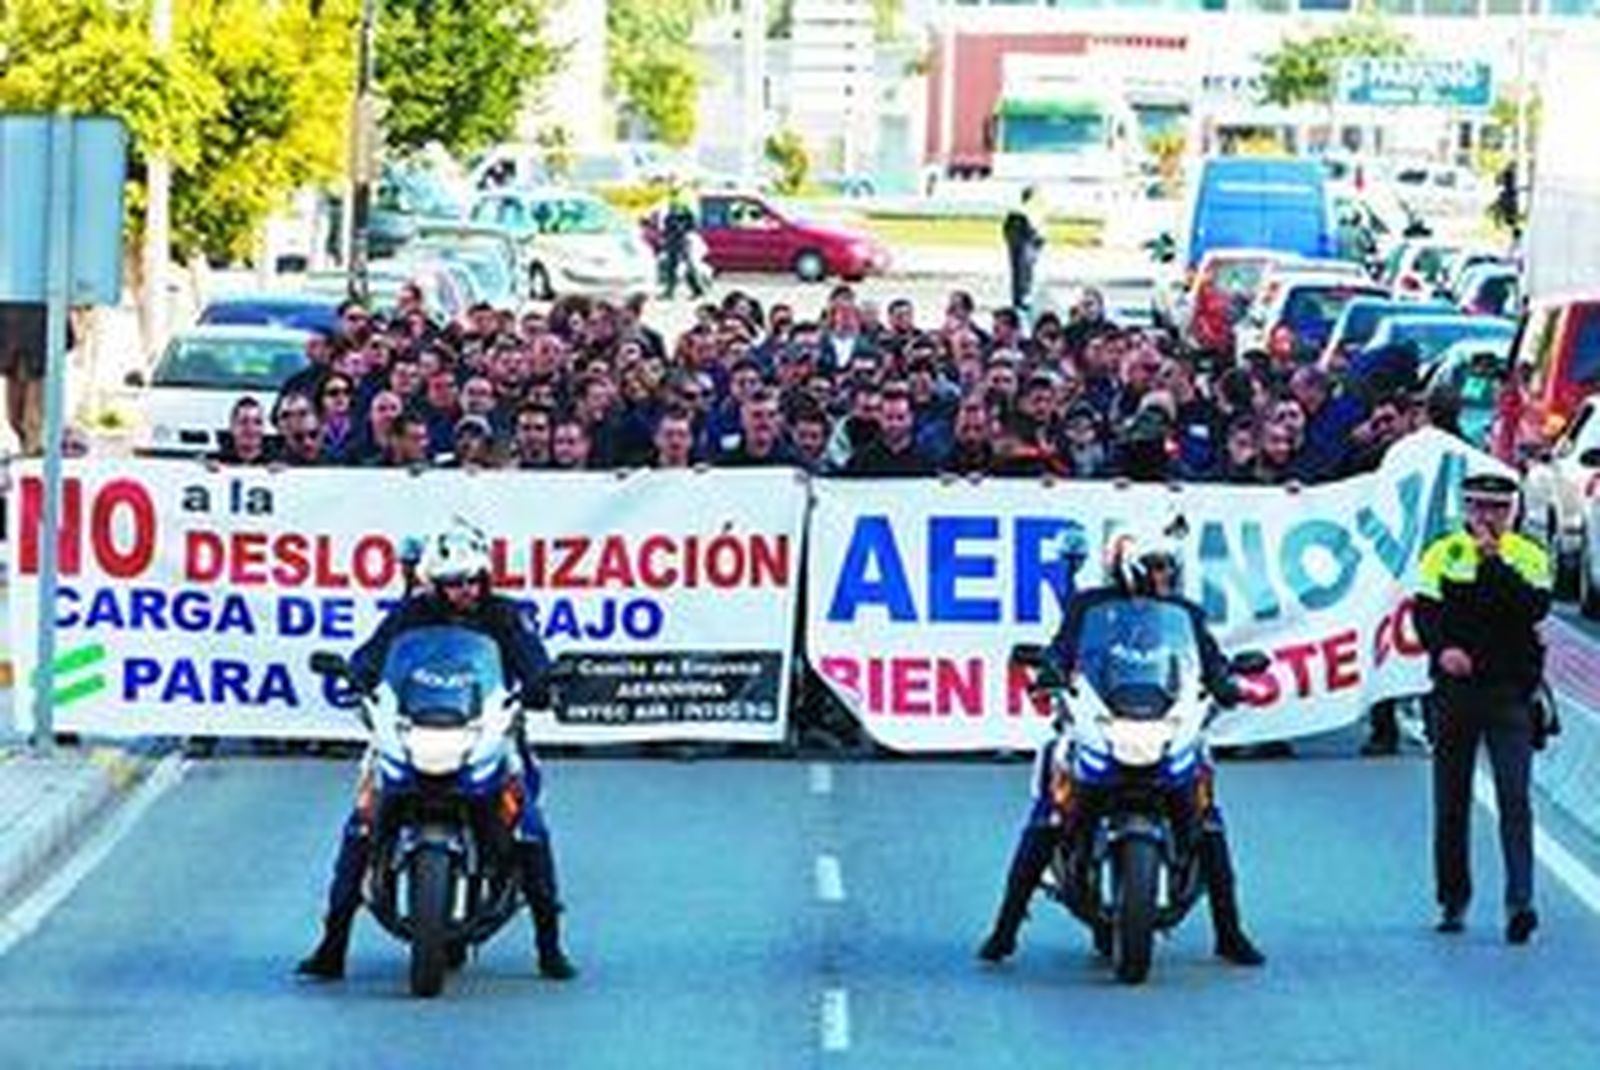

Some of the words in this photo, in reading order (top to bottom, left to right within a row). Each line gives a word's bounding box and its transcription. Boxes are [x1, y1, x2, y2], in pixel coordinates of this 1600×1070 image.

[18, 477, 155, 578] NO
[182, 485, 210, 513] a
[230, 479, 273, 514] la
[185, 521, 789, 589] DESLOLIZACIÓN
[826, 454, 1467, 625] AERNOVA
[54, 586, 255, 635] CARGA
[277, 596, 355, 639] DE
[122, 657, 299, 707] PARA
